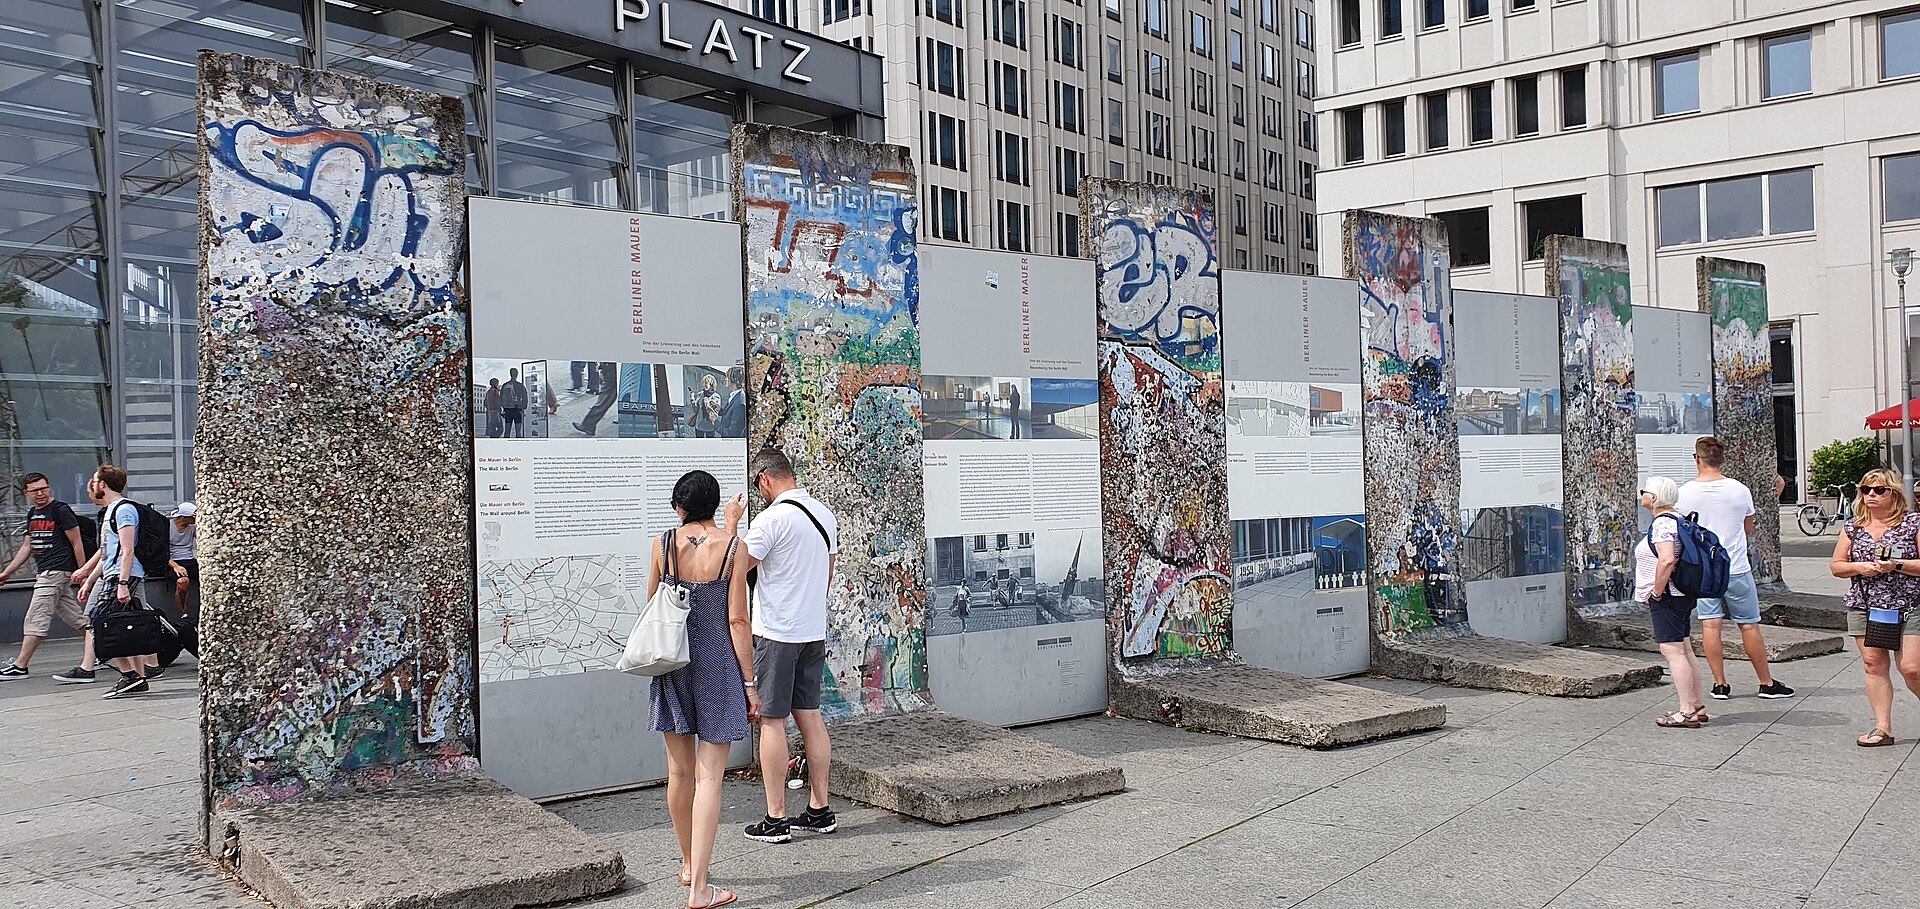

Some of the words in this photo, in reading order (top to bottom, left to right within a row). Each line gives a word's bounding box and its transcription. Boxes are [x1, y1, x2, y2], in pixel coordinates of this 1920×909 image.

[615, 0, 813, 84] PLATZ
[630, 217, 641, 263] MAUER
[632, 270, 643, 334] BERLINER
[1021, 257, 1029, 296] MAUER
